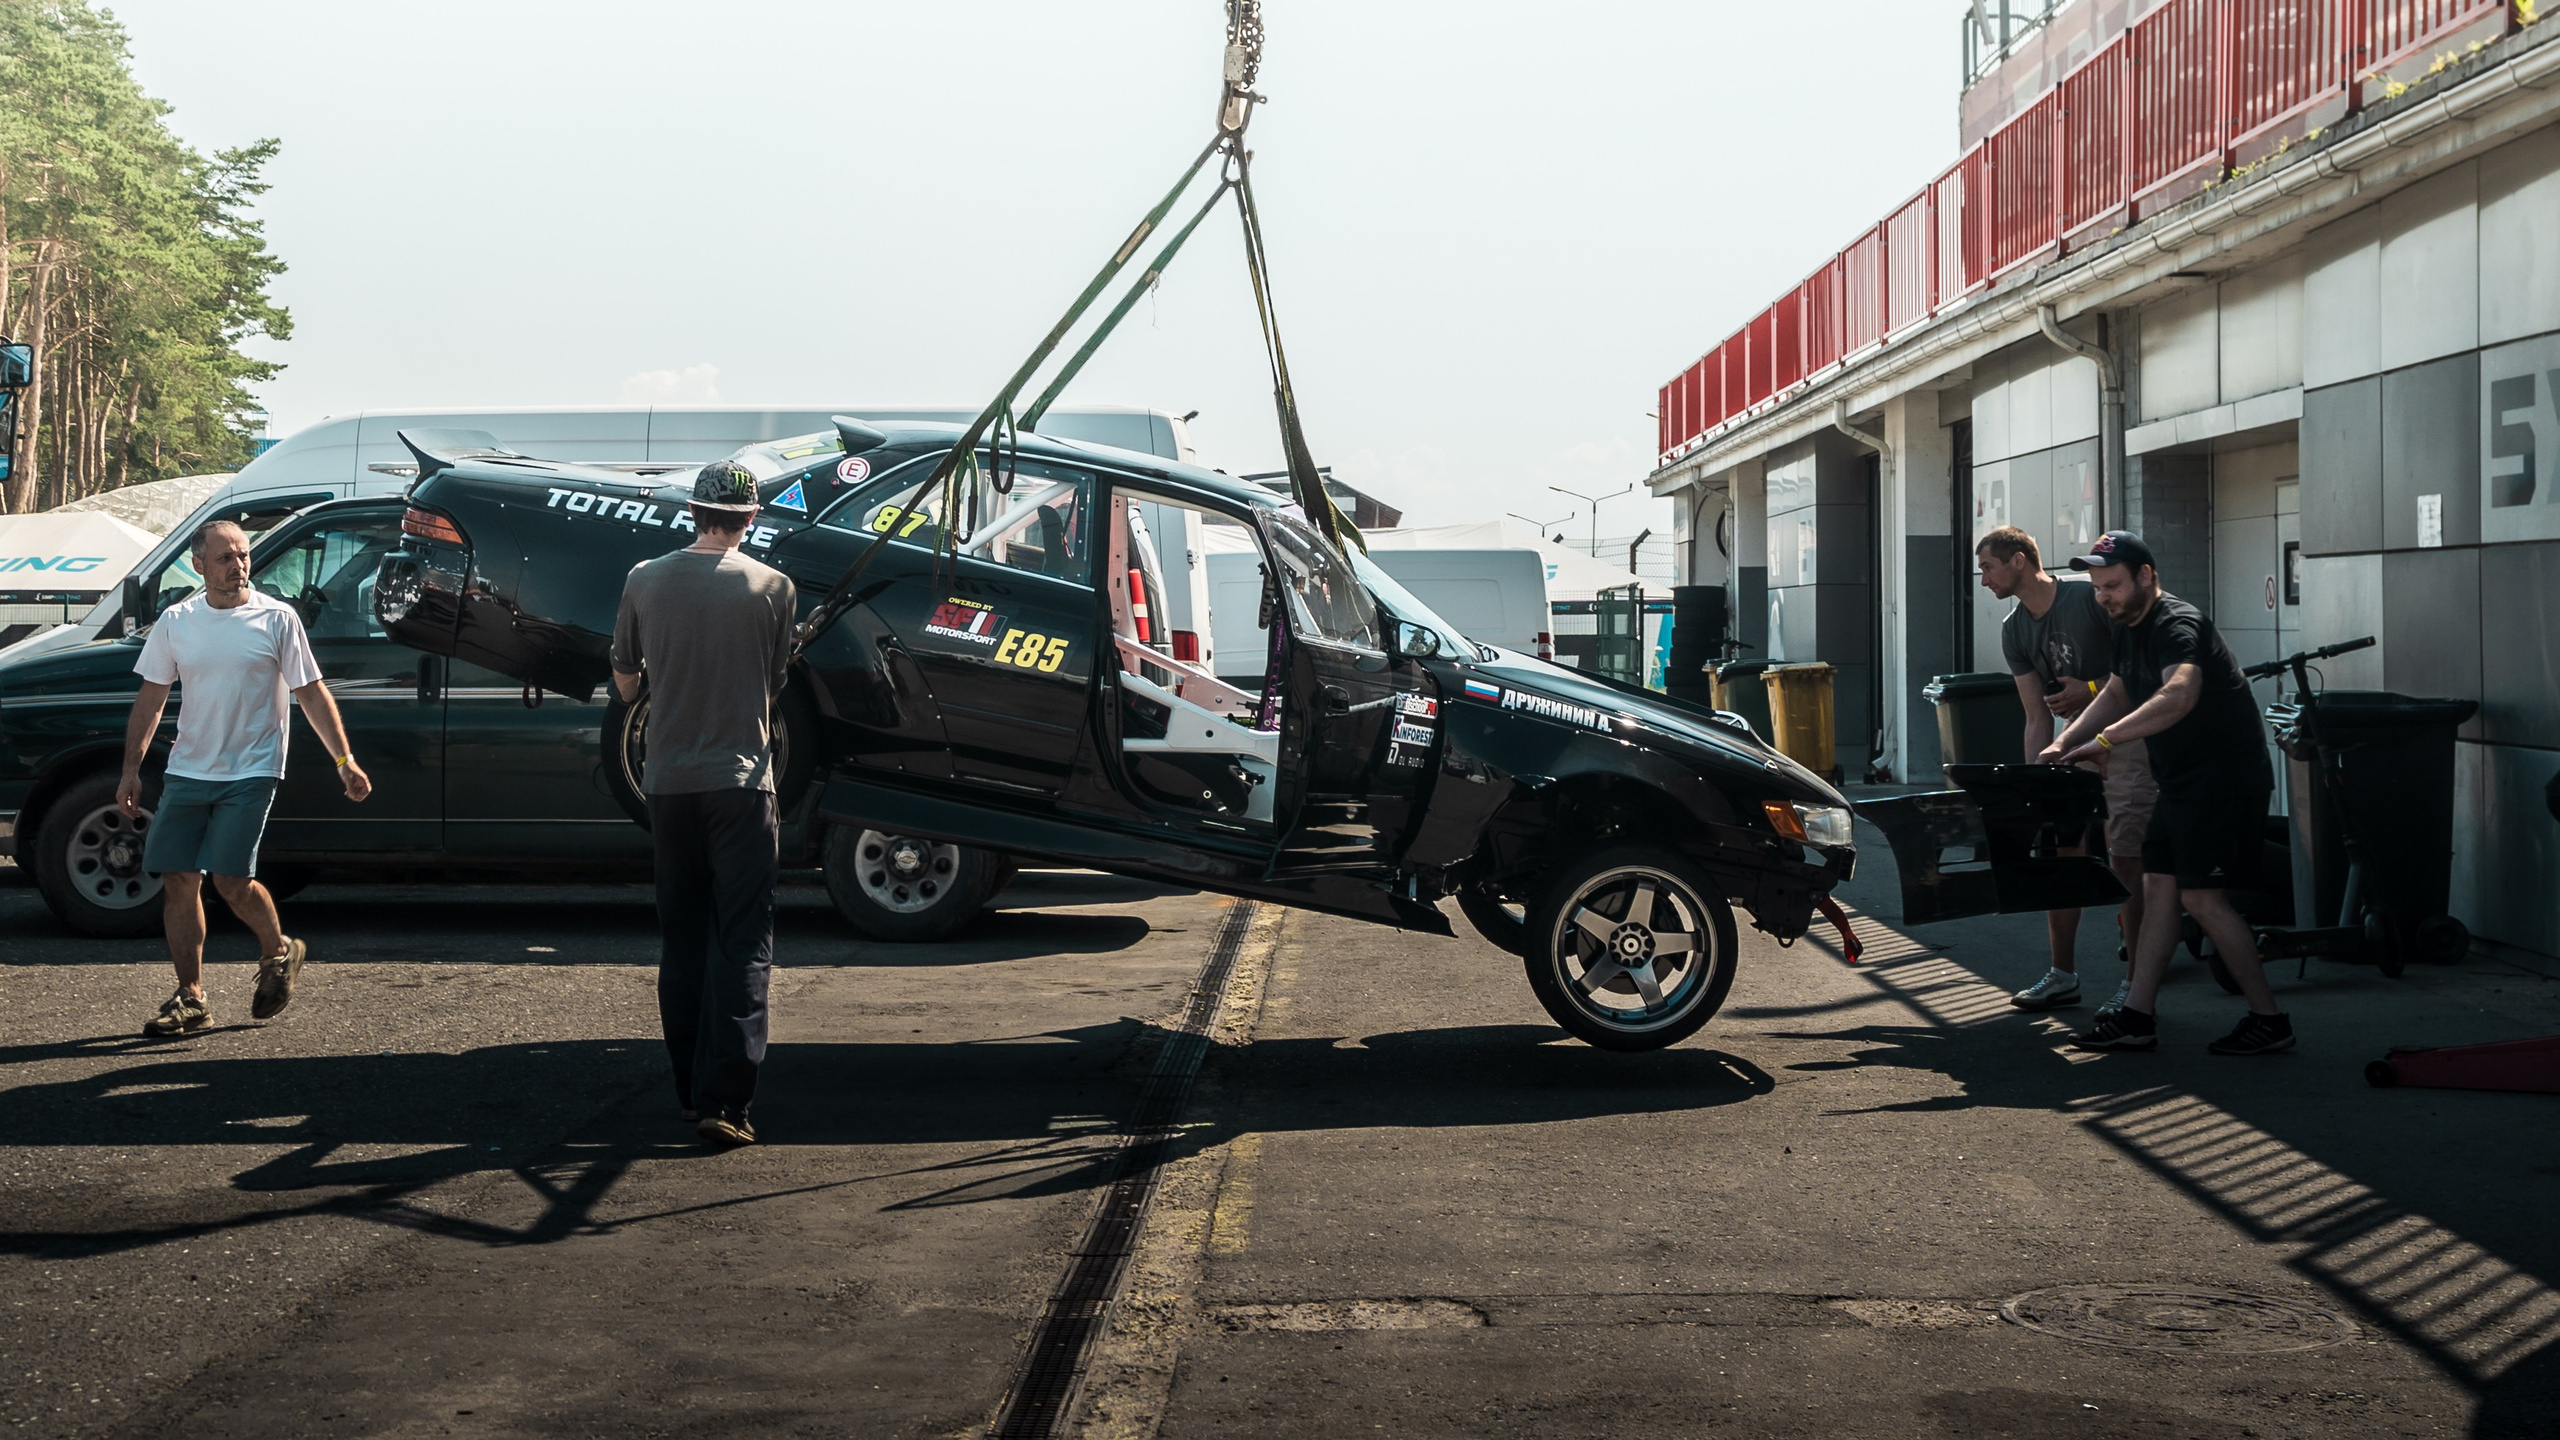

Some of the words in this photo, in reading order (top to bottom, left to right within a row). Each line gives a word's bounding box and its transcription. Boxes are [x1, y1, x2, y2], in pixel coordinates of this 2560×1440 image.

[846, 462, 861, 478] E
[547, 488, 663, 527] TOTAL
[669, 510, 779, 549] RE
[872, 504, 928, 538] 87
[925, 624, 997, 646] MOTORSPORT
[994, 628, 1069, 673] E85
[1501, 689, 1596, 728] ДРУЖИНИН
[1597, 714, 1612, 733] А.
[1392, 717, 1433, 744] KINFOREST
